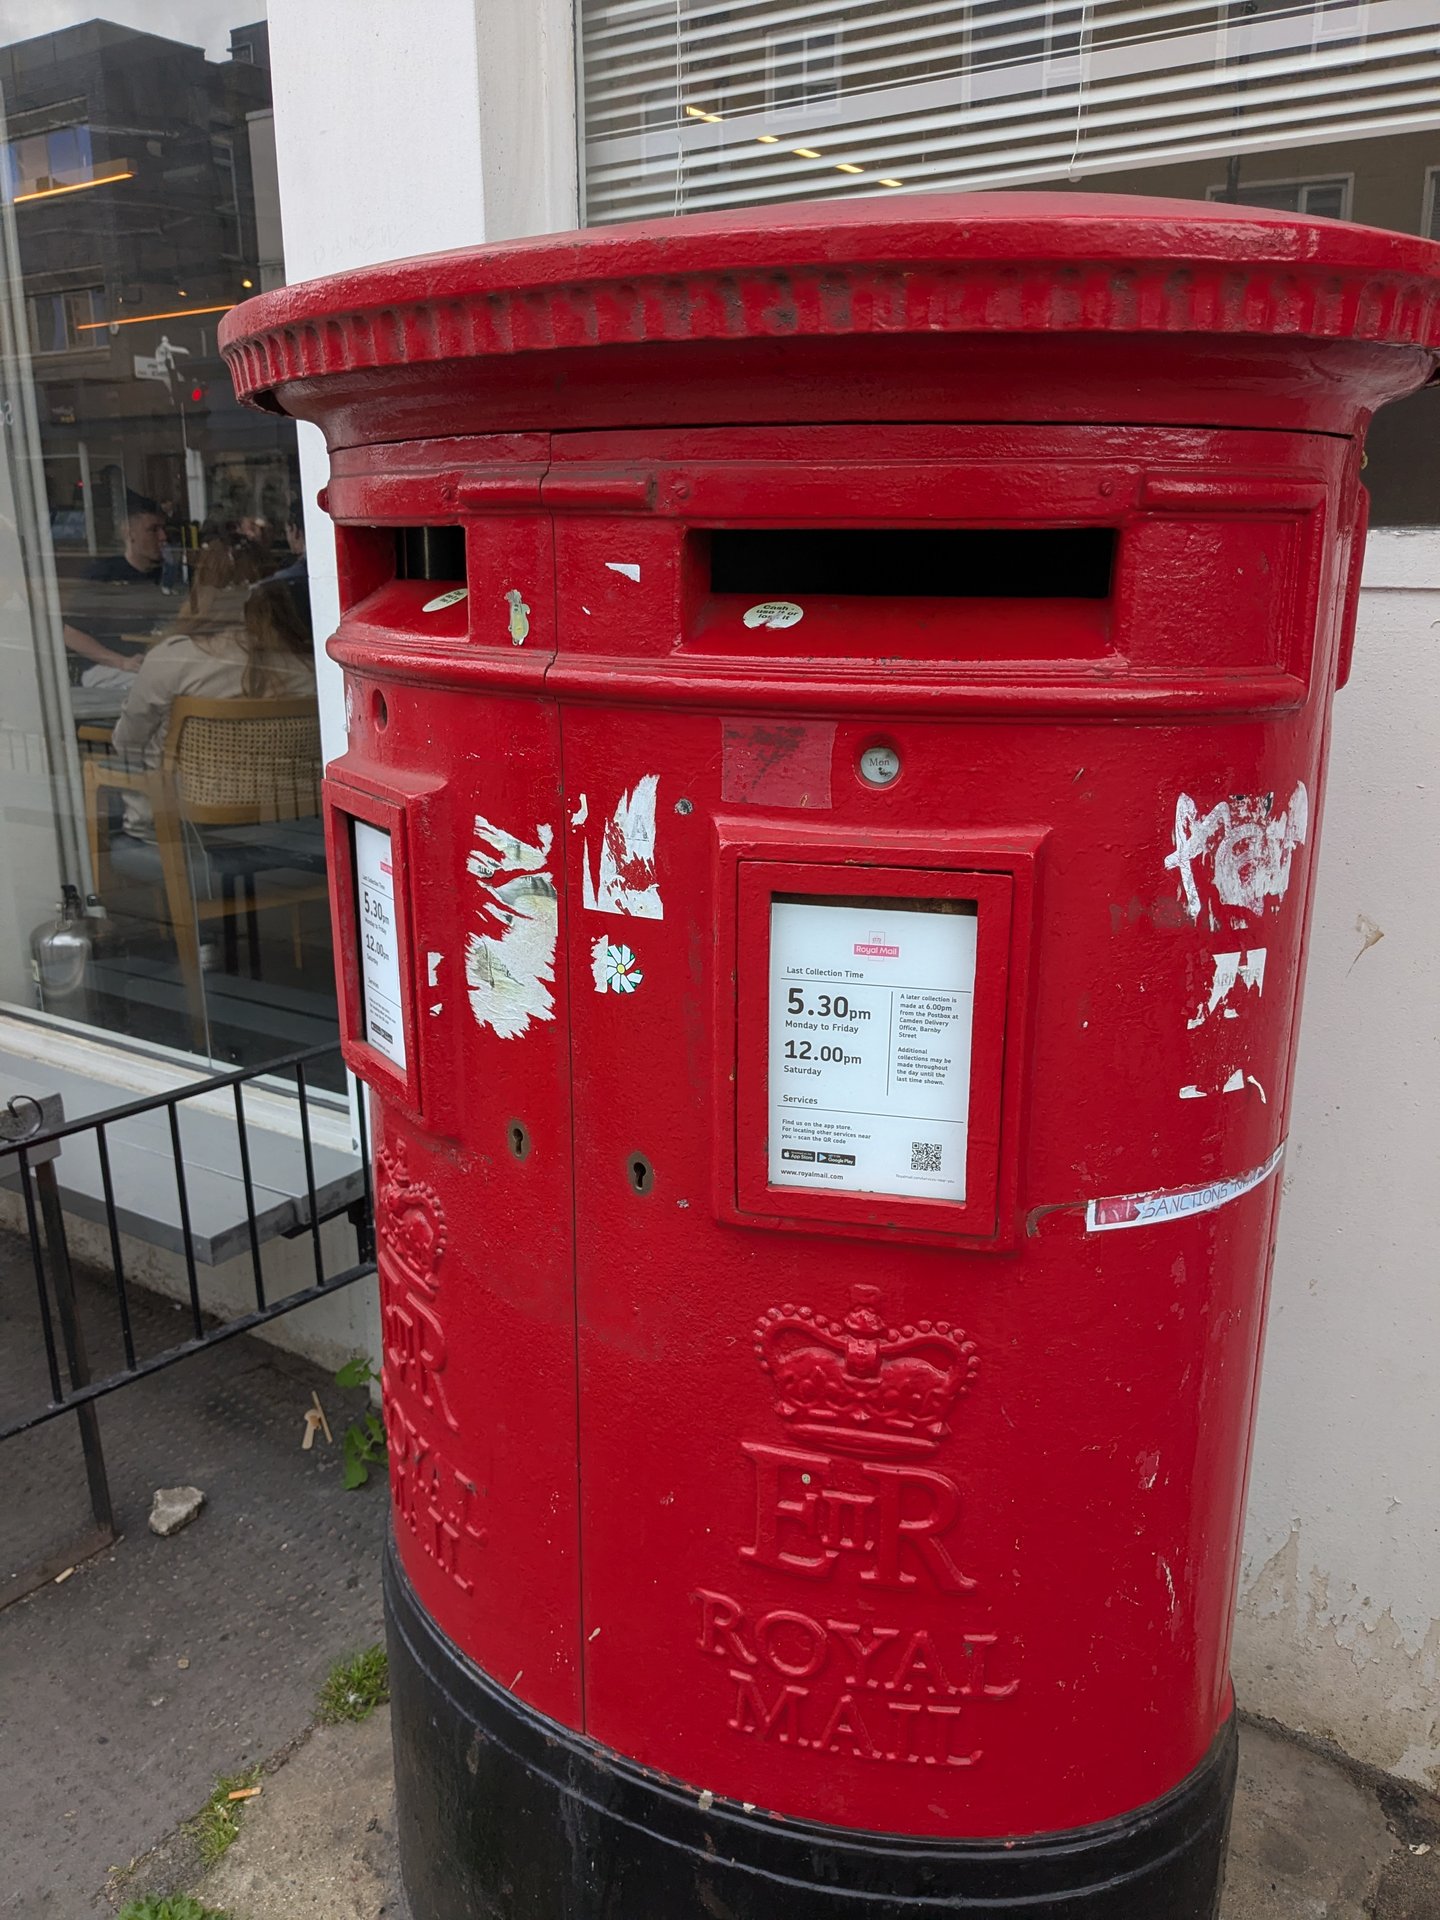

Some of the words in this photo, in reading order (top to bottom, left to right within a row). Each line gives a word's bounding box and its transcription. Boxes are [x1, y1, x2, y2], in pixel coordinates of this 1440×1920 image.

[869, 758, 890, 766] Mon
[364, 891, 389, 924] 5.30pm
[366, 934, 389, 960] 12.00pm
[856, 945, 878, 955] Royal
[880, 947, 897, 955] Mail
[786, 966, 803, 975] Last
[805, 968, 842, 977] Collection
[787, 988, 871, 1021] 5.30pm
[926, 1004, 952, 1012] 6.00pm
[785, 1020, 818, 1031] Monday
[821, 1022, 829, 1030] to
[832, 1023, 859, 1034] Friday
[925, 1019, 949, 1027] Delivery
[920, 1026, 941, 1034] Barnby
[784, 1040, 862, 1065] 12.00pm
[783, 1065, 822, 1077] Saturday
[915, 1063, 948, 1071] throughout
[783, 1095, 818, 1104] Services
[781, 1169, 843, 1180] www.royalmail.com
[1142, 1185, 1228, 1220] SANCTIONS
[693, 1587, 1021, 1698] ROYAL
[726, 1669, 984, 1769] MAIL
